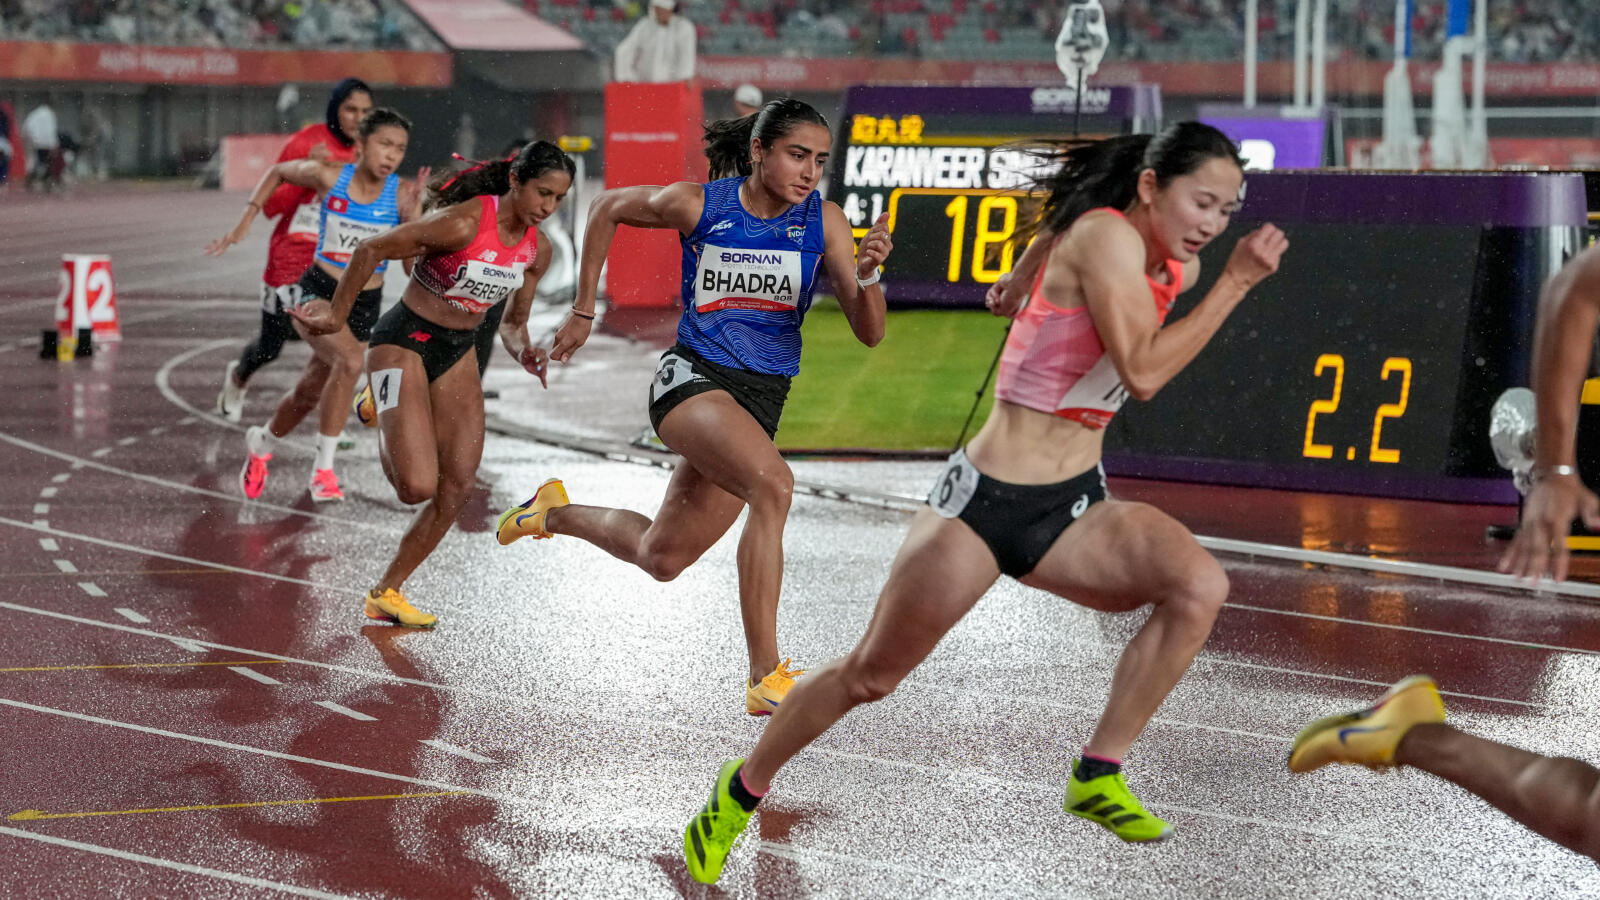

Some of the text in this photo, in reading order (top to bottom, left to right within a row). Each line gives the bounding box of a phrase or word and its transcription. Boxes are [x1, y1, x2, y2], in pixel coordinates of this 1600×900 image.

[720, 252, 782, 265] BORNAN
[483, 267, 517, 280] BORNAN
[702, 269, 793, 295] BHADRA
[89, 268, 114, 320] 2
[379, 374, 390, 405] 4
[938, 465, 962, 509] 6
